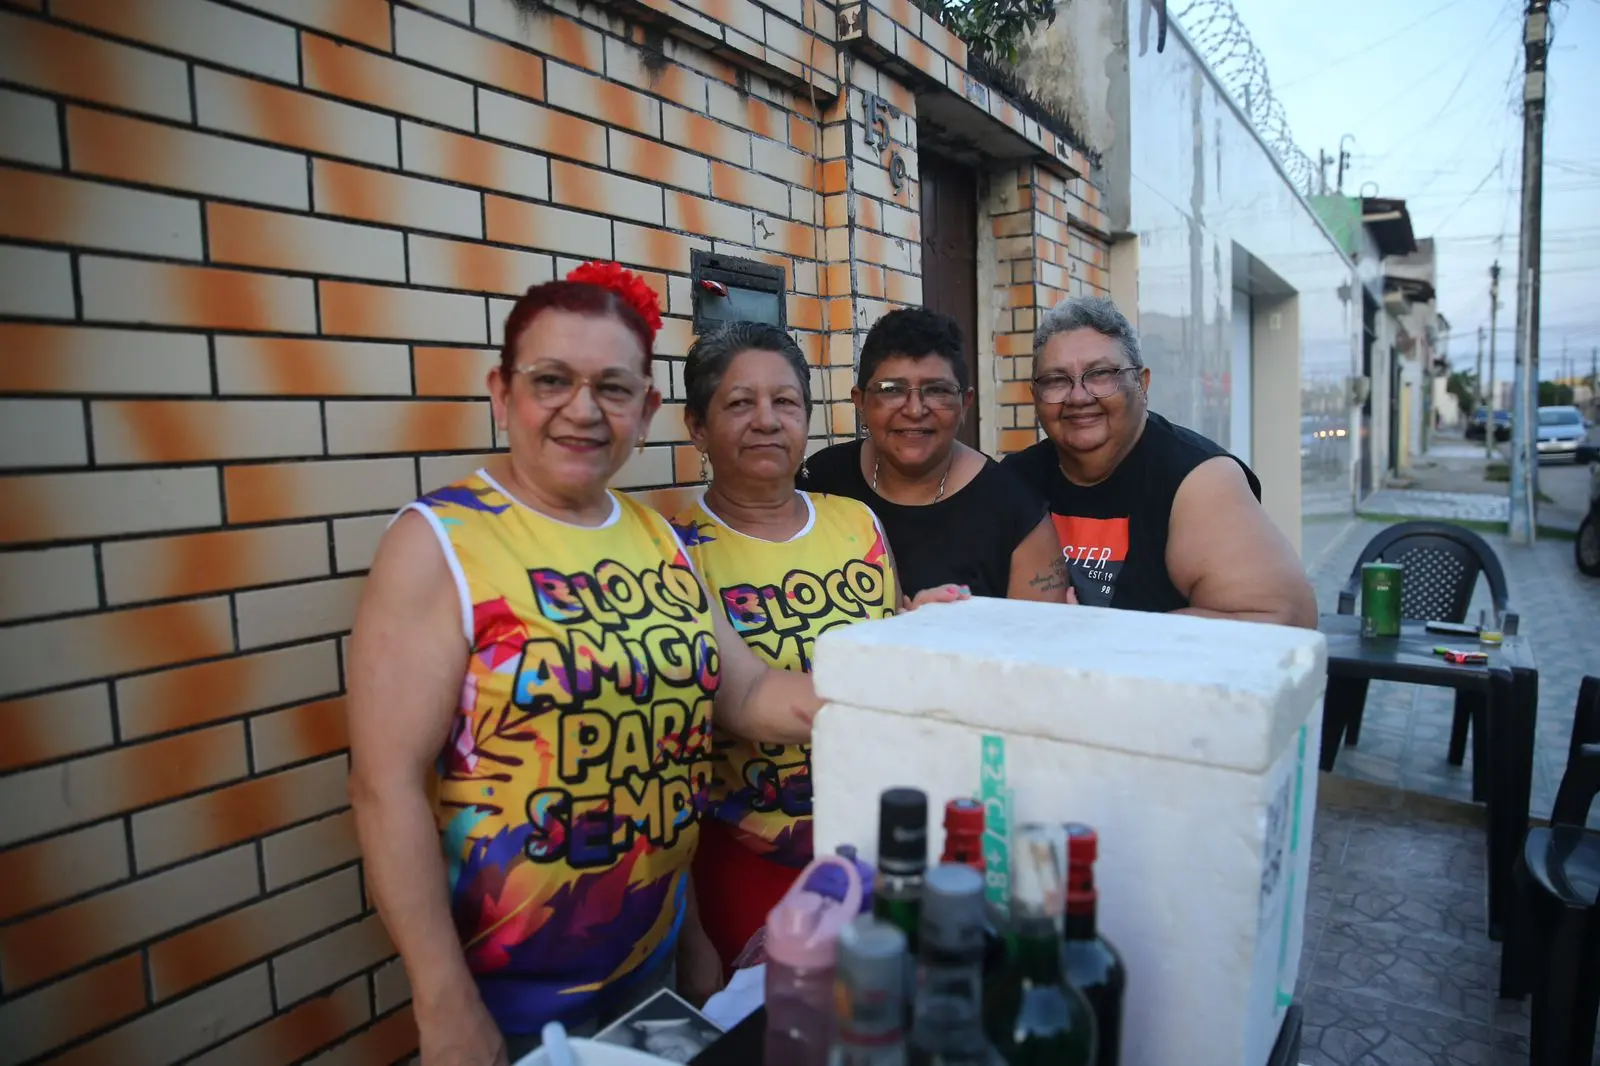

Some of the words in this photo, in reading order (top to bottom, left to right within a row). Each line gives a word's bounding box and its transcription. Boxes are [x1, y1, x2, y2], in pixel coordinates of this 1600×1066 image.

[527, 559, 706, 626] BLOCO
[720, 560, 883, 634] BLOCO
[513, 625, 720, 709] AMIGO
